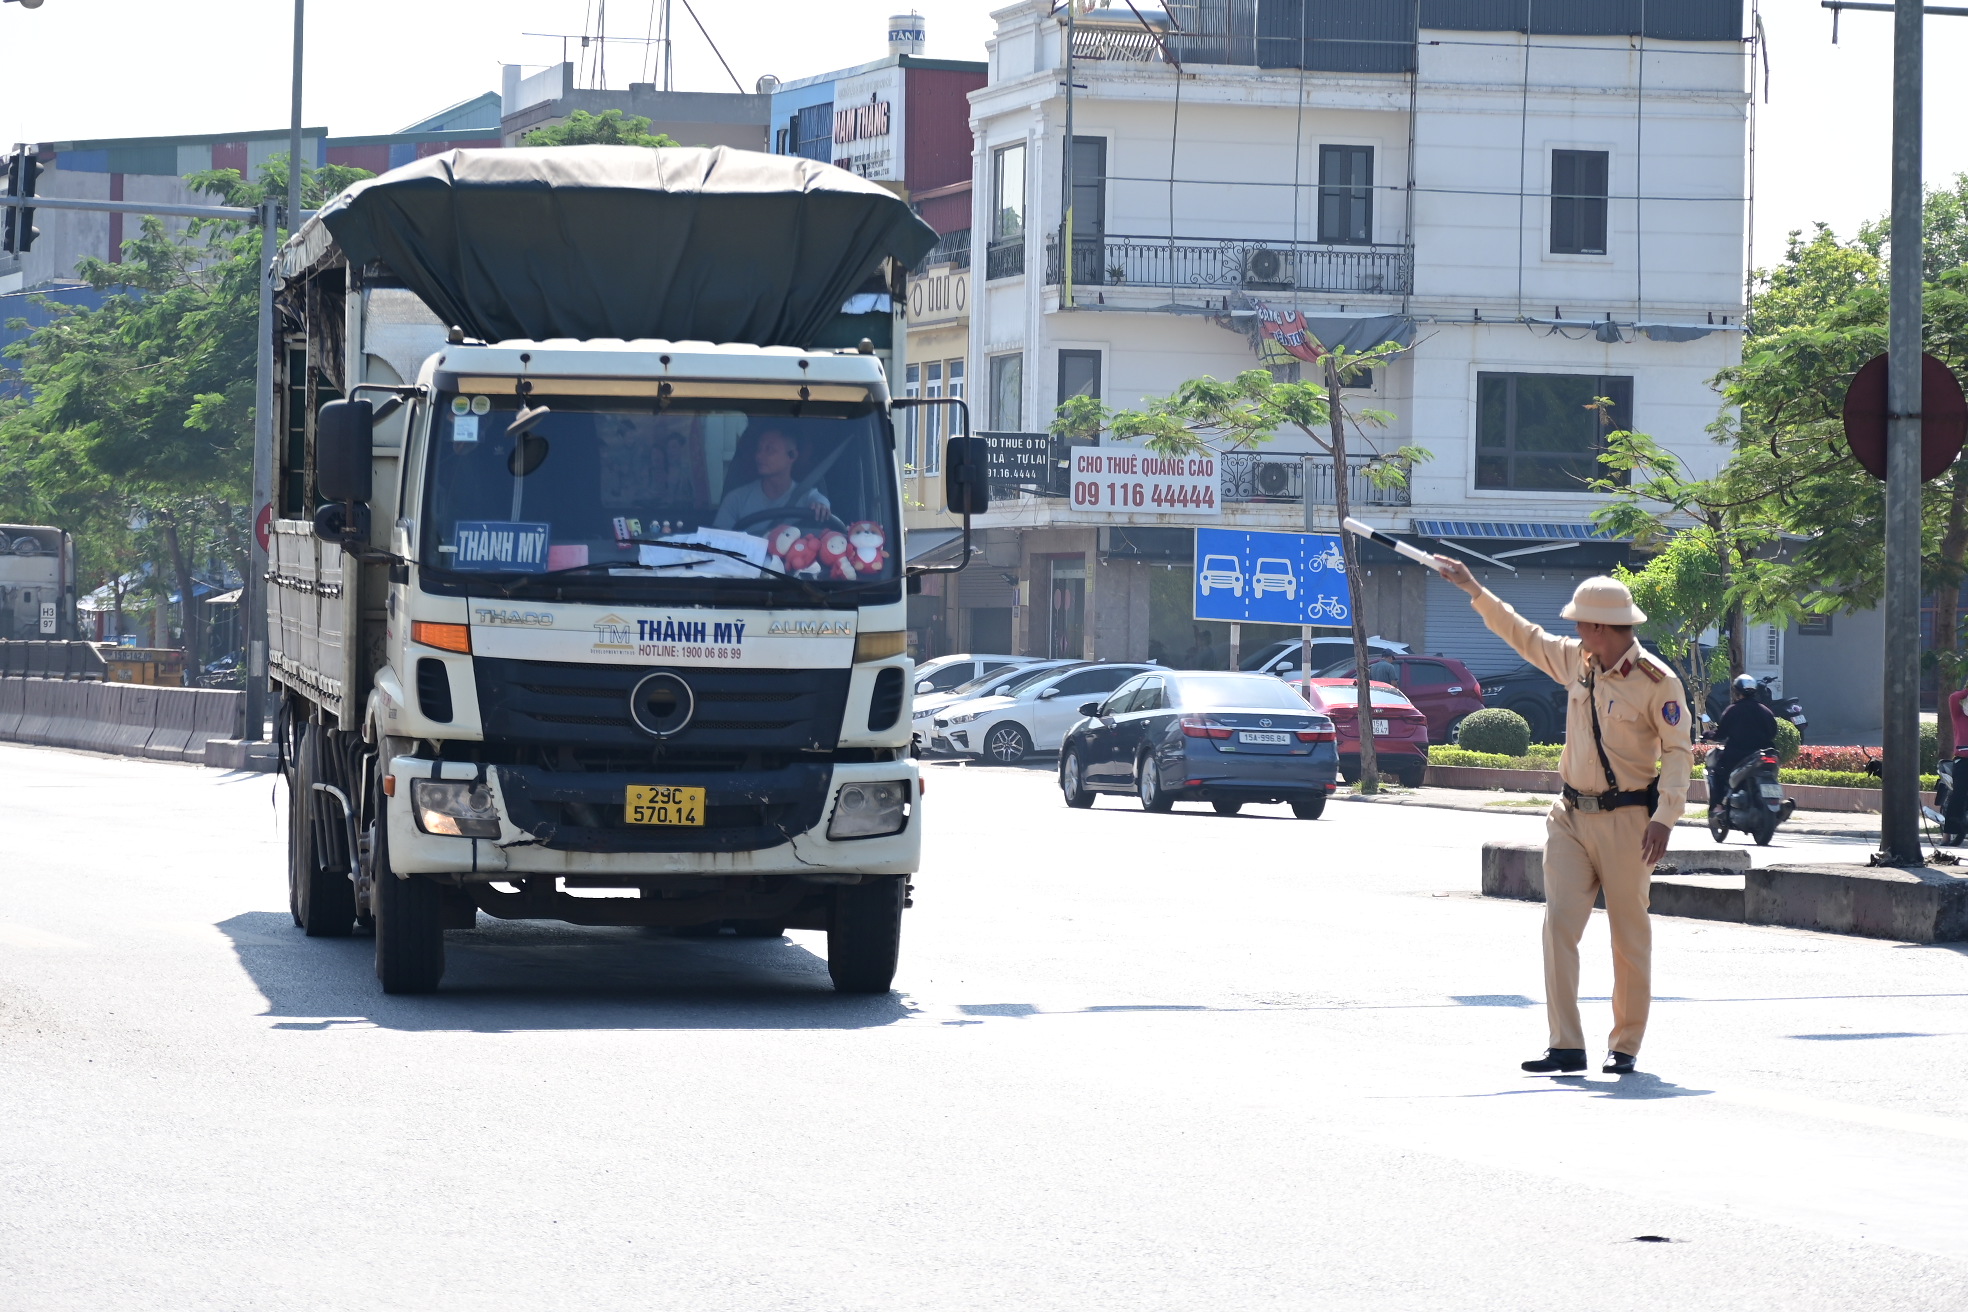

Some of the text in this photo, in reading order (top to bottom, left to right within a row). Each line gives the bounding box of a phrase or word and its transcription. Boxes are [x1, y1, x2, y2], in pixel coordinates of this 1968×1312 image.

[891, 30, 913, 41] TÂN
[986, 437, 998, 448] HO
[1077, 455, 1103, 474] CHO
[1106, 453, 1138, 475] THUÊ
[987, 468, 1037, 479] 91.16.4444
[1074, 481, 1215, 509] 09 116 44444
[459, 524, 546, 564] THÀNH MỸ
[42, 607, 54, 617] H3
[475, 608, 554, 627] THACO
[43, 620, 53, 628] 97
[637, 615, 746, 645] THÀNH MỸ
[767, 620, 852, 636] AUMAN
[593, 624, 631, 645] TM
[638, 644, 742, 660] HOTLINE: 1900 06 86 99
[648, 787, 683, 805] 29C
[633, 805, 696, 824] 570.14
